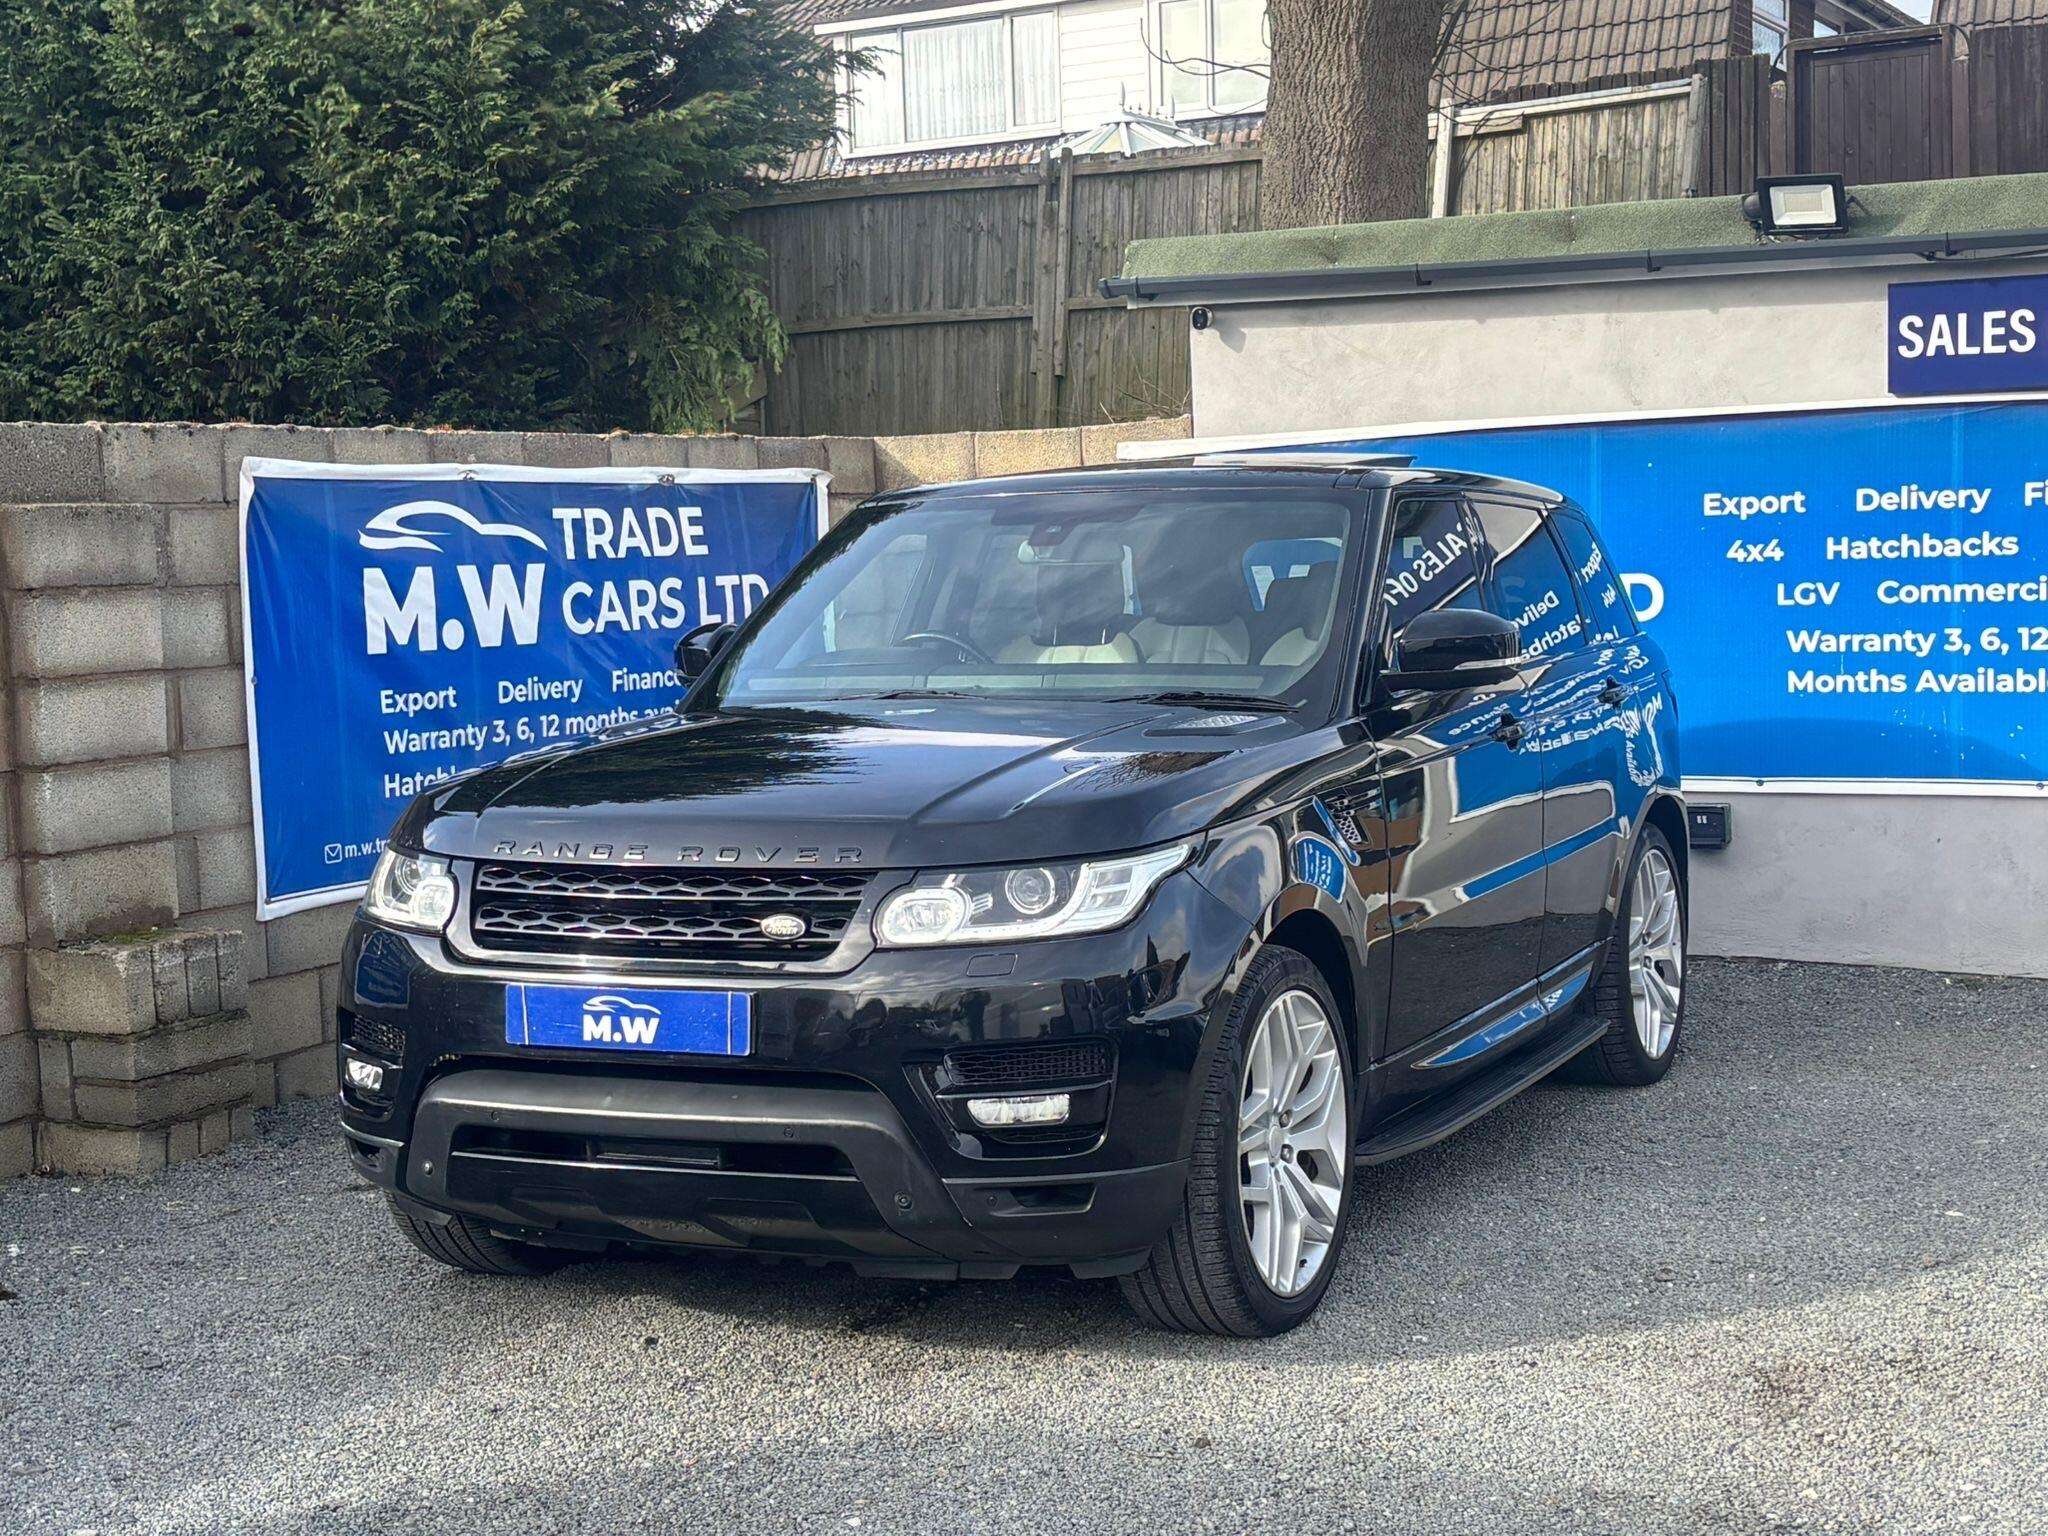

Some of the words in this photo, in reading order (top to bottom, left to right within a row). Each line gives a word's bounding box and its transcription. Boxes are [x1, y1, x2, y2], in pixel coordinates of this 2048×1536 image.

[1897, 308, 2036, 359] SALES
[1703, 491, 1806, 520] Export
[1856, 484, 1991, 515] Delivery
[552, 506, 709, 560] TRADE
[1726, 539, 1785, 563] 4x4
[1826, 531, 2019, 560] Hatchbacks
[562, 577, 686, 635] CARS
[697, 573, 770, 626] LTD
[1777, 582, 1840, 606] LGV
[1877, 575, 2048, 604] Commerci
[363, 563, 546, 655] M.W
[1786, 630, 1936, 657] Warranty
[1944, 627, 1971, 656] 3,
[1980, 627, 2010, 656] 6,
[2017, 626, 2048, 652] 12
[380, 686, 457, 714] Export
[498, 676, 582, 705] Delivery
[1787, 668, 1907, 693] Months
[1915, 666, 2048, 693] Availabl
[383, 722, 487, 755] Warranty
[492, 720, 511, 745] 3,
[516, 717, 535, 743] 6,
[539, 714, 560, 738] 12
[344, 837, 391, 859] m.w.tr
[493, 840, 649, 861] RANGE
[676, 845, 863, 863] ROVER
[582, 1014, 660, 1045] M.W
